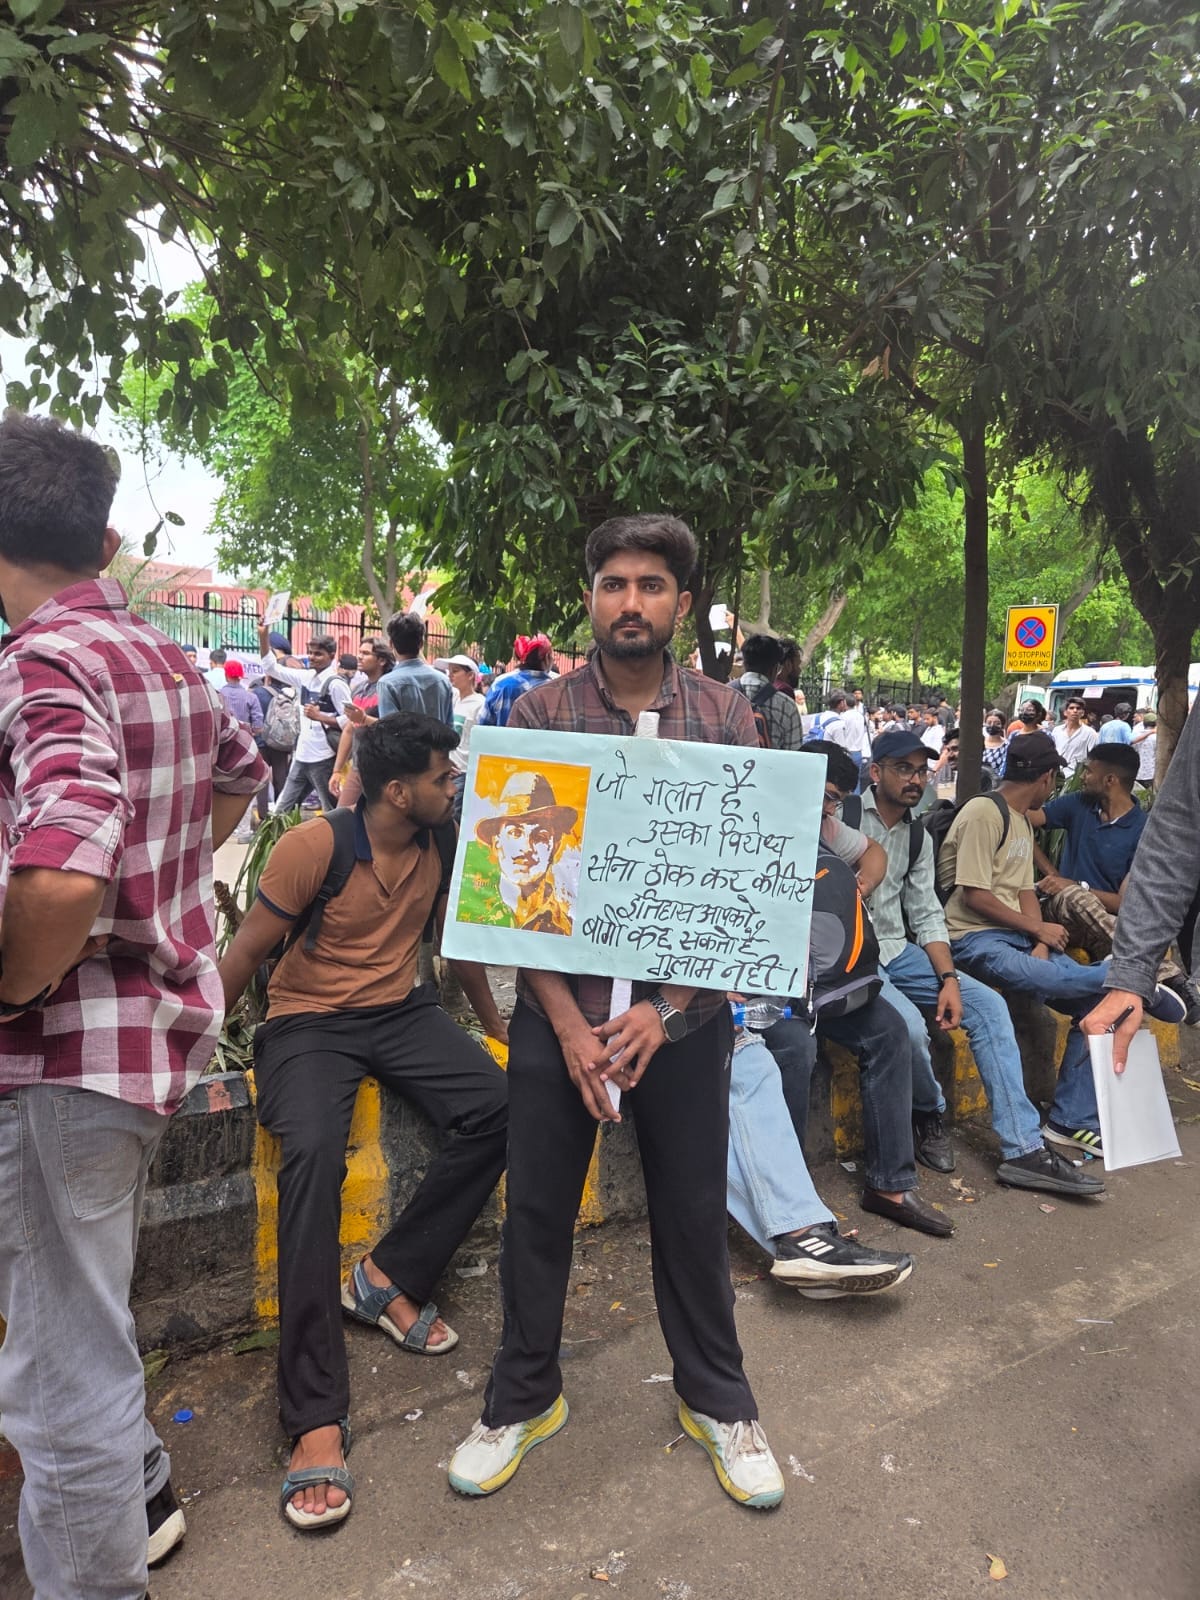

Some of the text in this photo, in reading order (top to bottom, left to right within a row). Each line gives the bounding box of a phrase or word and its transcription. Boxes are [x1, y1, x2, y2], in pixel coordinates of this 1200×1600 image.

[1008, 659, 1048, 667] NO PARKING
[596, 749, 757, 823] जो गलत है
[627, 811, 795, 858] उसका विरोध
[586, 843, 645, 884] सीना
[643, 848, 697, 888] ठोक
[699, 866, 755, 893] कर
[582, 904, 629, 948] बागी
[627, 925, 673, 951] कह
[738, 919, 770, 957] है
[616, 888, 761, 929] इतिहास आपको
[647, 952, 725, 981] गुलाम
